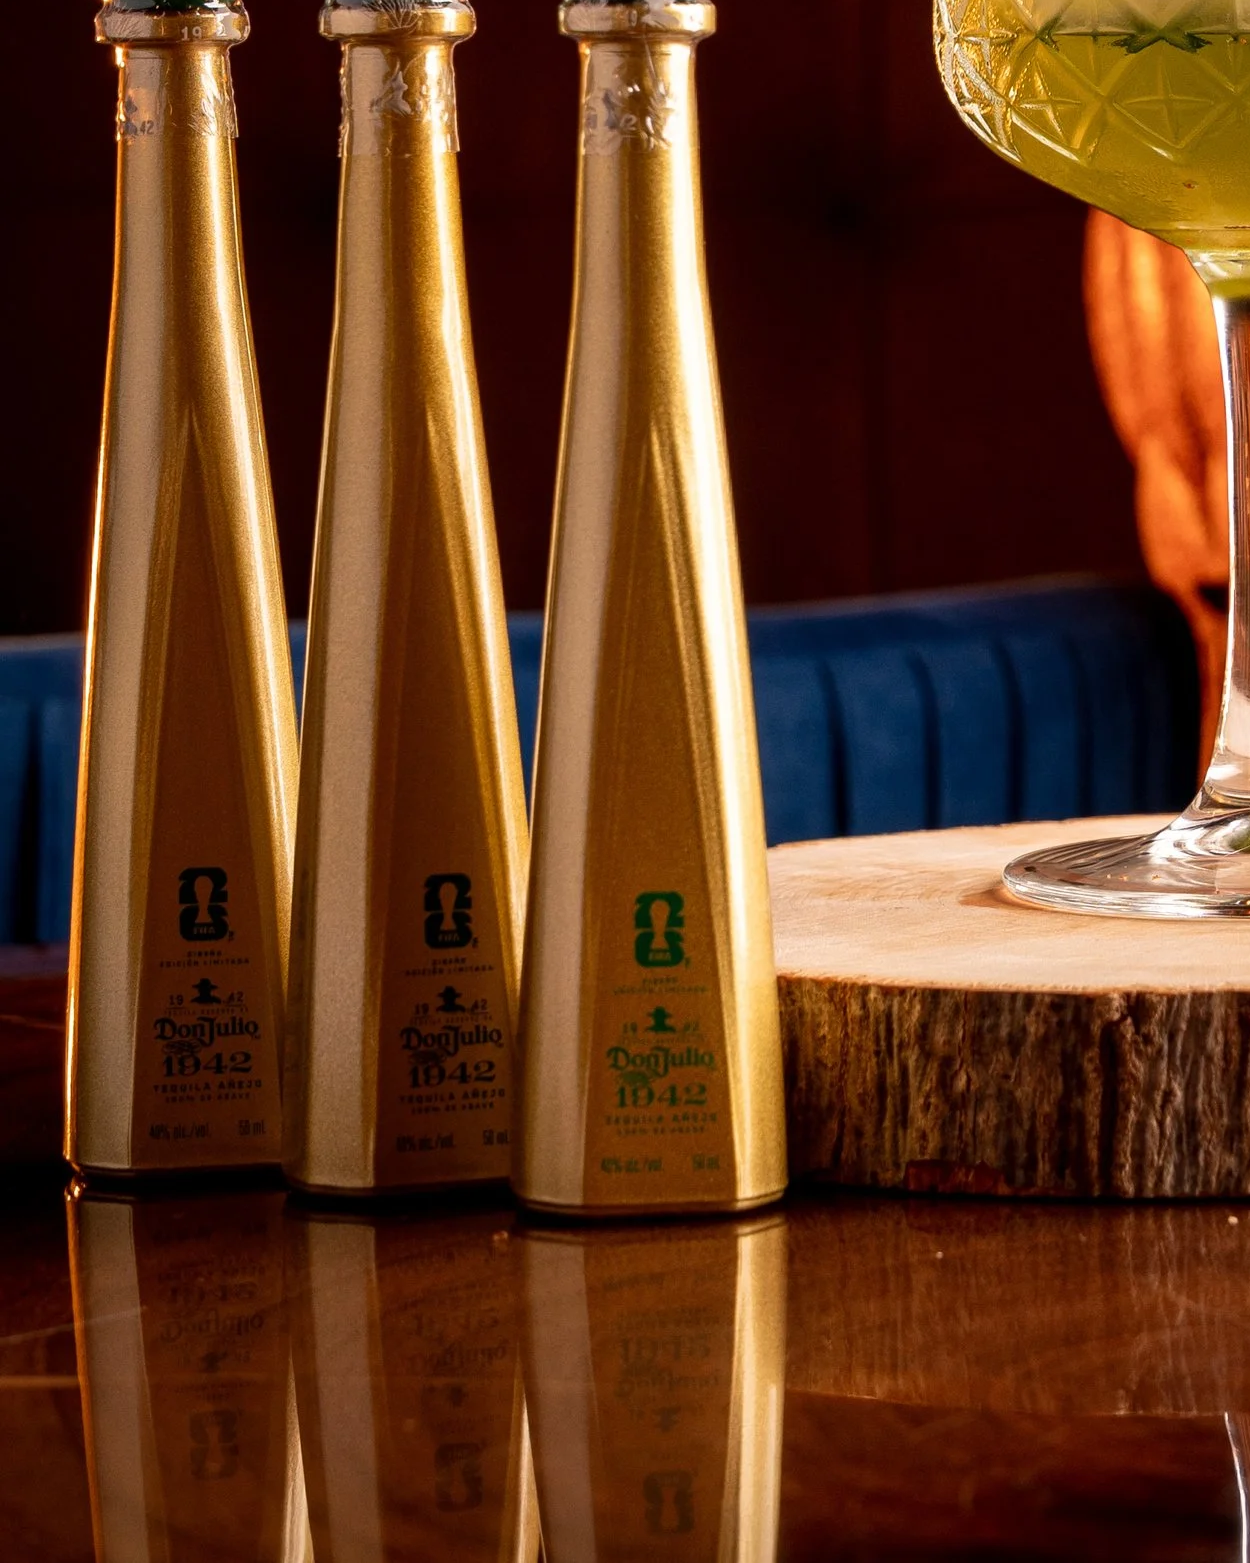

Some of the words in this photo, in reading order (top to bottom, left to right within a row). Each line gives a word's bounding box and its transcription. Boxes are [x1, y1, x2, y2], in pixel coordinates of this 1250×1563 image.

[169, 994, 184, 1006] 19
[163, 1051, 252, 1077] 1942
[409, 1060, 497, 1089] 1942
[153, 1082, 211, 1094] TEQUILA
[618, 1083, 707, 1109] 1942
